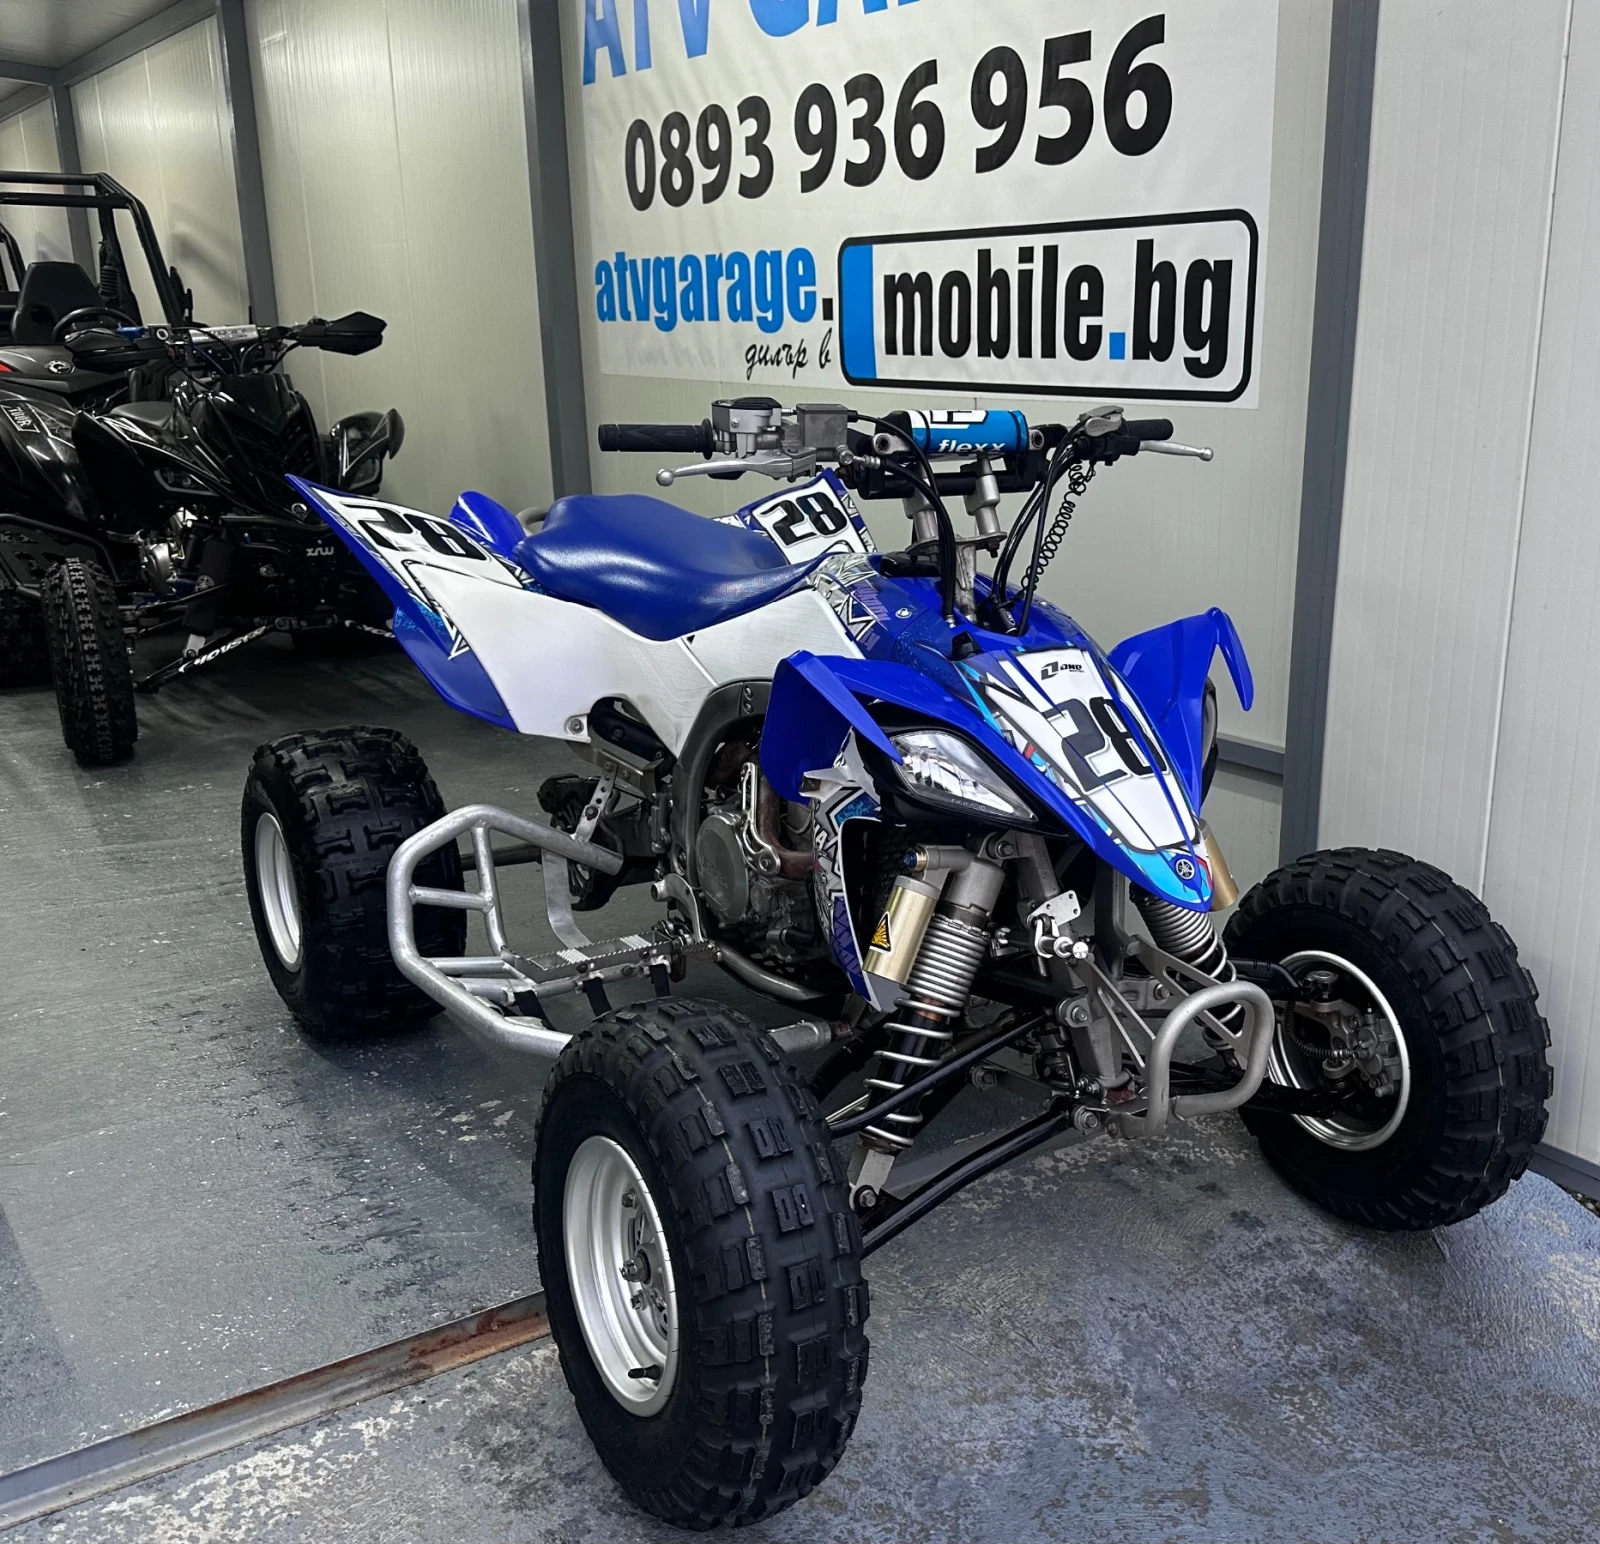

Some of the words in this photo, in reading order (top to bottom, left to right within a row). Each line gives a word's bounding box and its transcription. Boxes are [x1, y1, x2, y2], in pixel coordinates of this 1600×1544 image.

[624, 95, 775, 212] 0893
[793, 58, 946, 194] 936
[970, 13, 1174, 174] 956
[594, 246, 835, 334] atvgarage.
[883, 237, 1234, 379] mobile.bg
[744, 338, 809, 381] дилър
[937, 438, 1006, 454] flexx
[341, 500, 489, 561] 28
[758, 490, 849, 547] 28
[1043, 695, 1170, 794] 28
